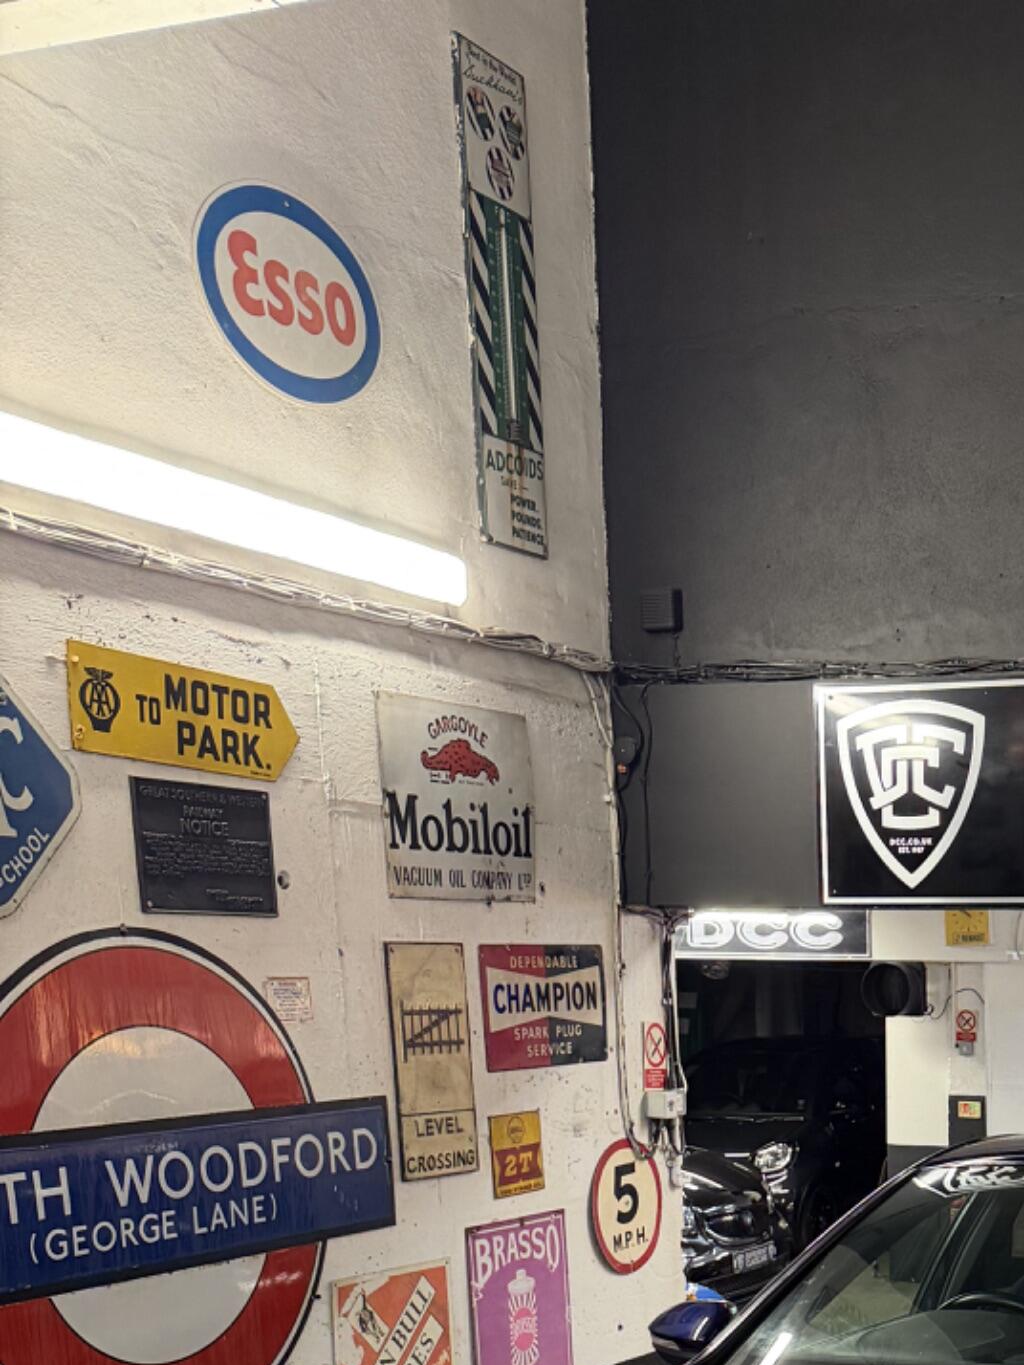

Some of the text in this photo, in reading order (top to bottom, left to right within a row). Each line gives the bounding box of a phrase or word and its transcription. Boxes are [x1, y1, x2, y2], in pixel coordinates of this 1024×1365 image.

[227, 229, 356, 347] ESSO
[486, 448, 544, 481] ADCOIDS
[135, 673, 273, 729] TO MOTOR
[177, 720, 272, 771] PARK.
[427, 714, 488, 749] GARGOYLE
[180, 818, 230, 836] NOTICE
[383, 787, 533, 858] Mobiloil
[393, 866, 443, 887] VACUUM
[449, 869, 467, 888] OIL
[472, 869, 512, 890] COMPANY
[687, 911, 844, 950] DCC
[509, 955, 578, 969] DEPENDABLE
[492, 980, 598, 1015] CHAMPION
[513, 1024, 582, 1041] SPARK PLUG
[527, 1041, 573, 1058] SERVICE
[414, 1115, 464, 1138] LEVEL
[104, 1127, 378, 1208] WOODFORD
[406, 1149, 475, 1173] CROSSING
[504, 1151, 533, 1178] 2T
[613, 1161, 640, 1225] 5
[29, 1193, 278, 1265] (GEORGE LANE)
[475, 1223, 561, 1290] BRASSO
[390, 1287, 434, 1350] BULL
